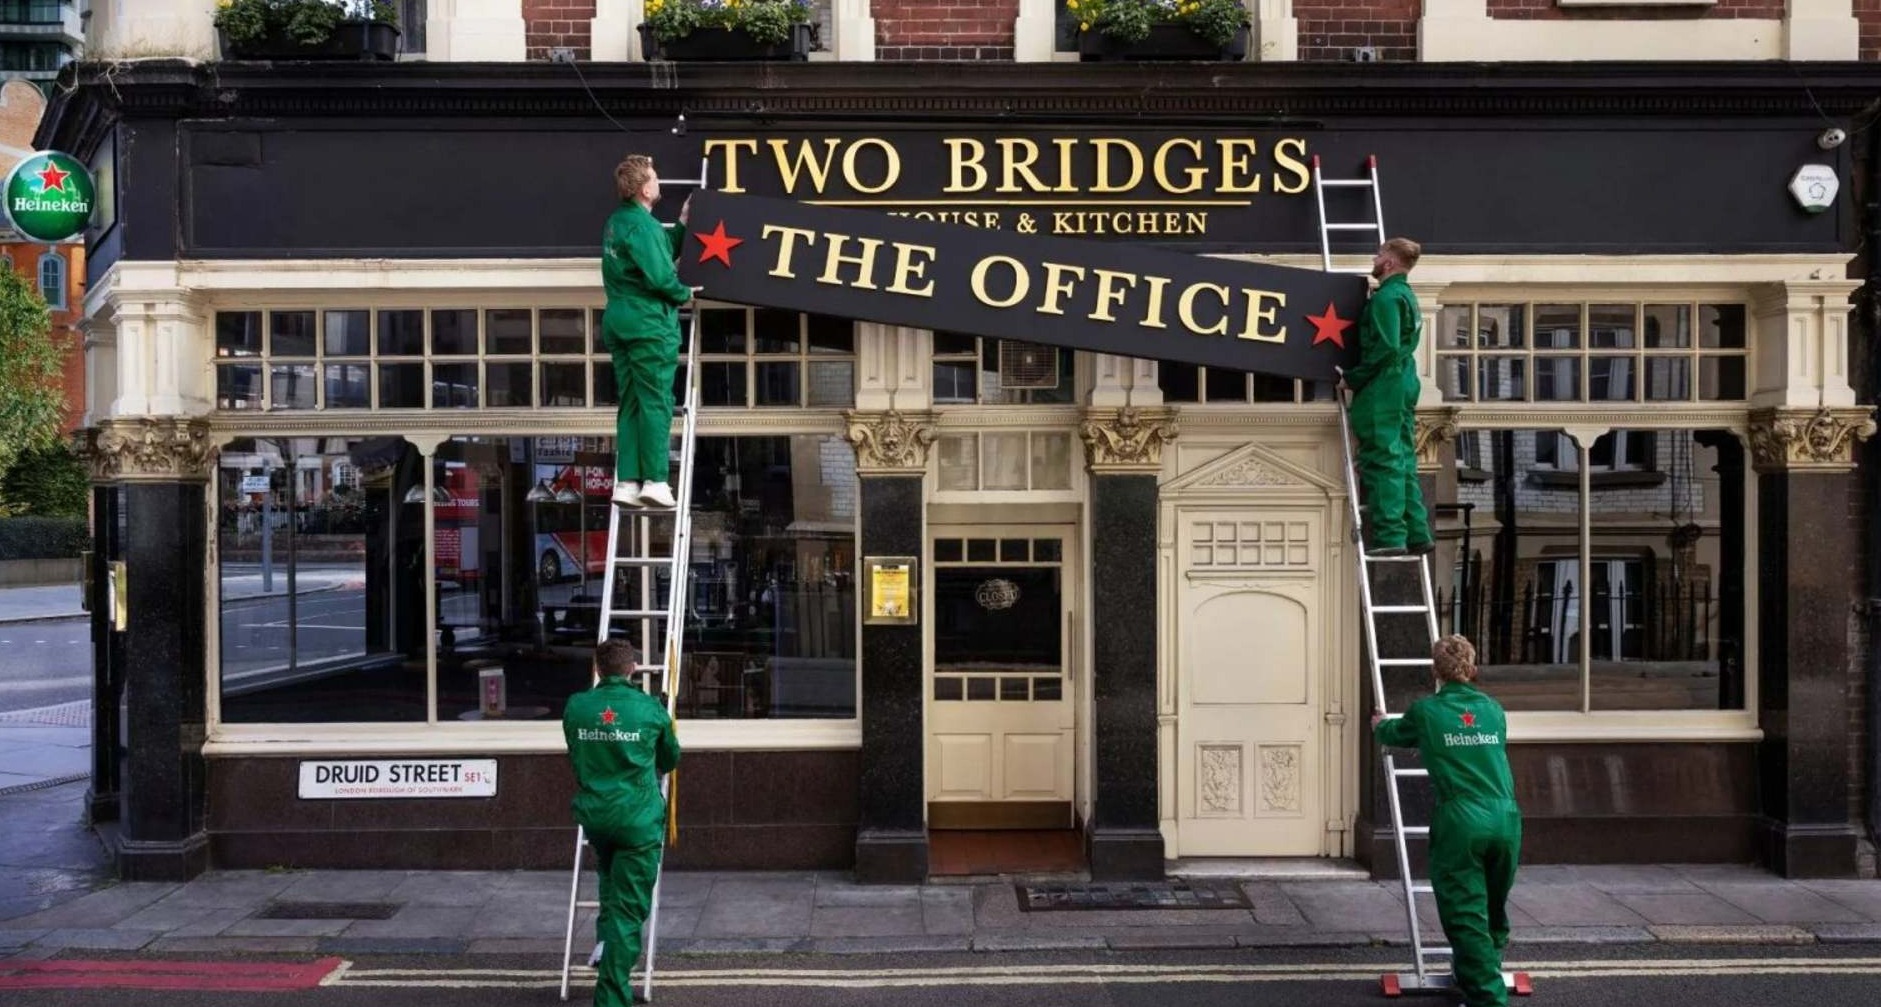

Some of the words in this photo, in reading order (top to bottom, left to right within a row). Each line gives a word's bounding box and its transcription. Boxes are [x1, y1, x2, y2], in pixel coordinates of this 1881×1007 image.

[705, 137, 901, 194] TWO
[942, 137, 1311, 194] BRIDGES
[14, 197, 88, 213] Heineken
[887, 212, 1001, 229] USE
[1016, 212, 1038, 234] &
[1052, 212, 1208, 234] KITCHEN
[761, 223, 936, 298] THE
[970, 254, 1288, 345] OFFICE
[574, 465, 605, 477] HP-ON
[577, 728, 641, 742] Heineken
[1443, 732, 1499, 747] Heineken
[315, 764, 380, 784] DRUID
[388, 763, 462, 783] STREET
[464, 772, 482, 783] SE1
[334, 787, 367, 795] LONDON
